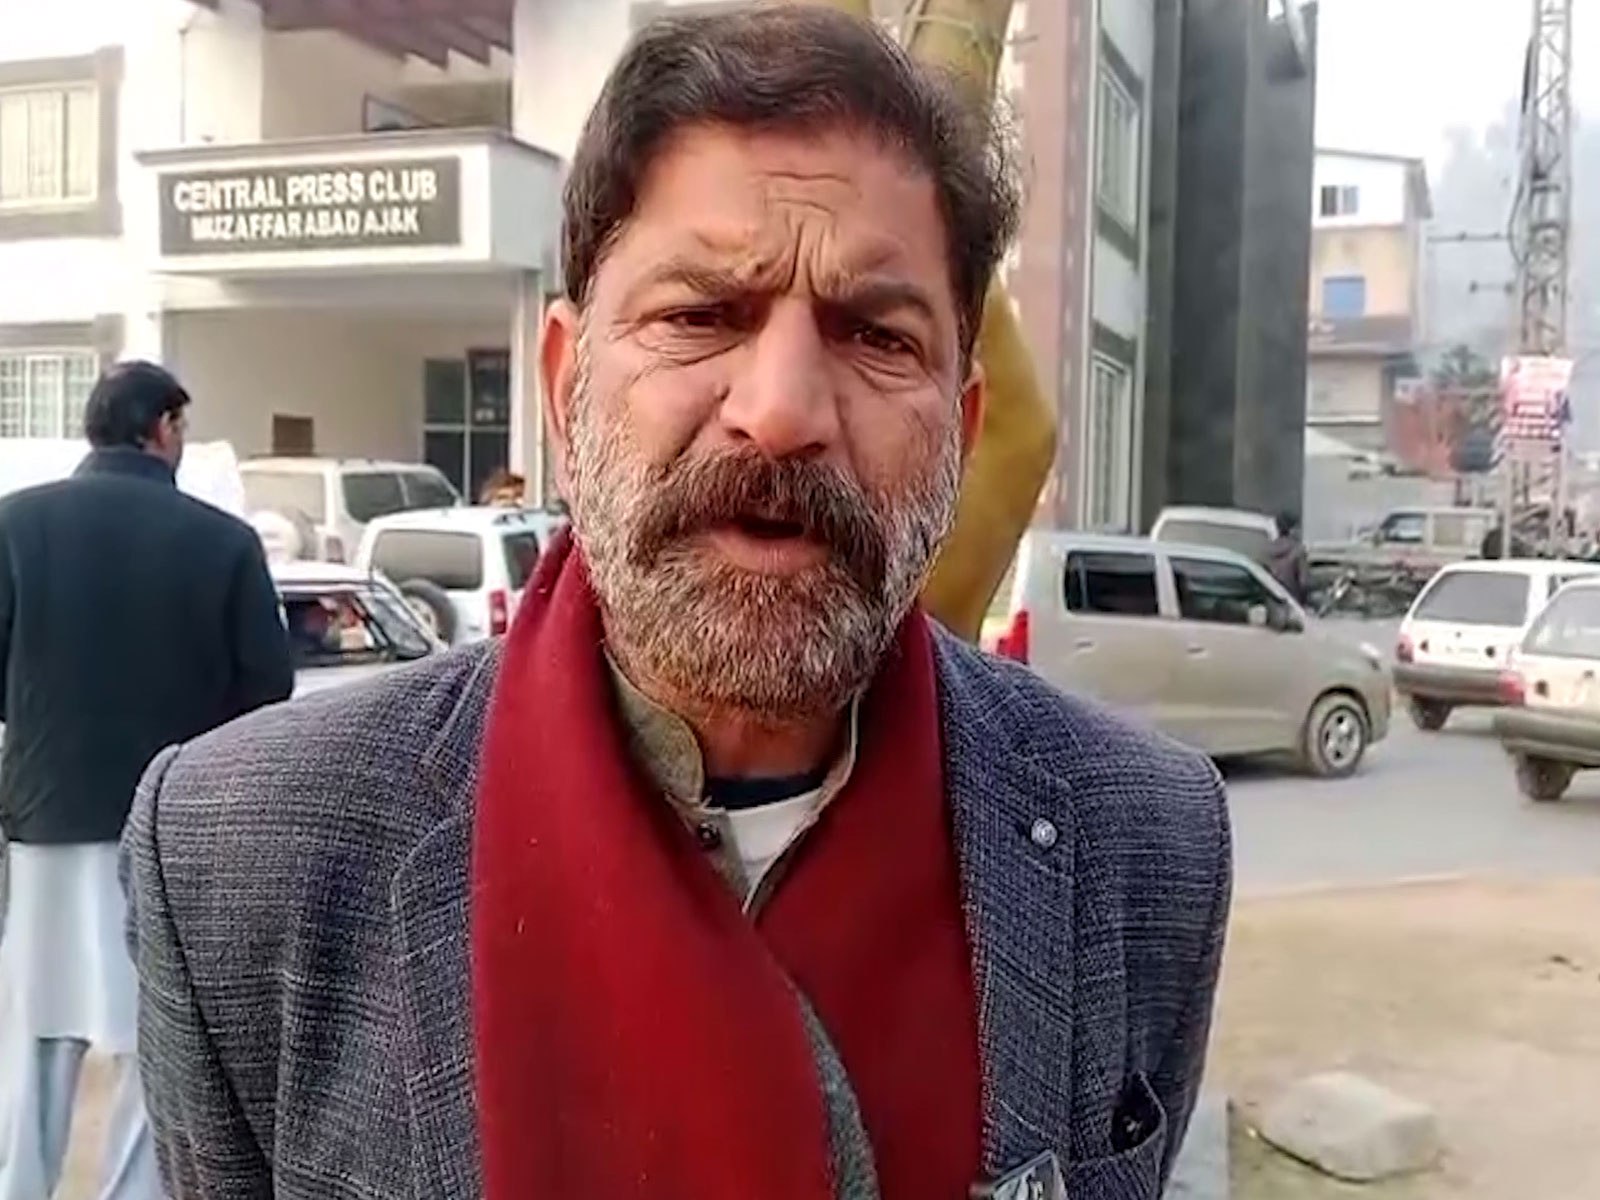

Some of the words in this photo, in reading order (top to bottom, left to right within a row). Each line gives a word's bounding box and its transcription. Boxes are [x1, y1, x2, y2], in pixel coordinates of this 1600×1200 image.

[173, 177, 284, 211] CENTRAL
[286, 171, 365, 206] PRESS
[368, 168, 437, 202] CLUB
[191, 208, 360, 240] MUZAFFARABAD
